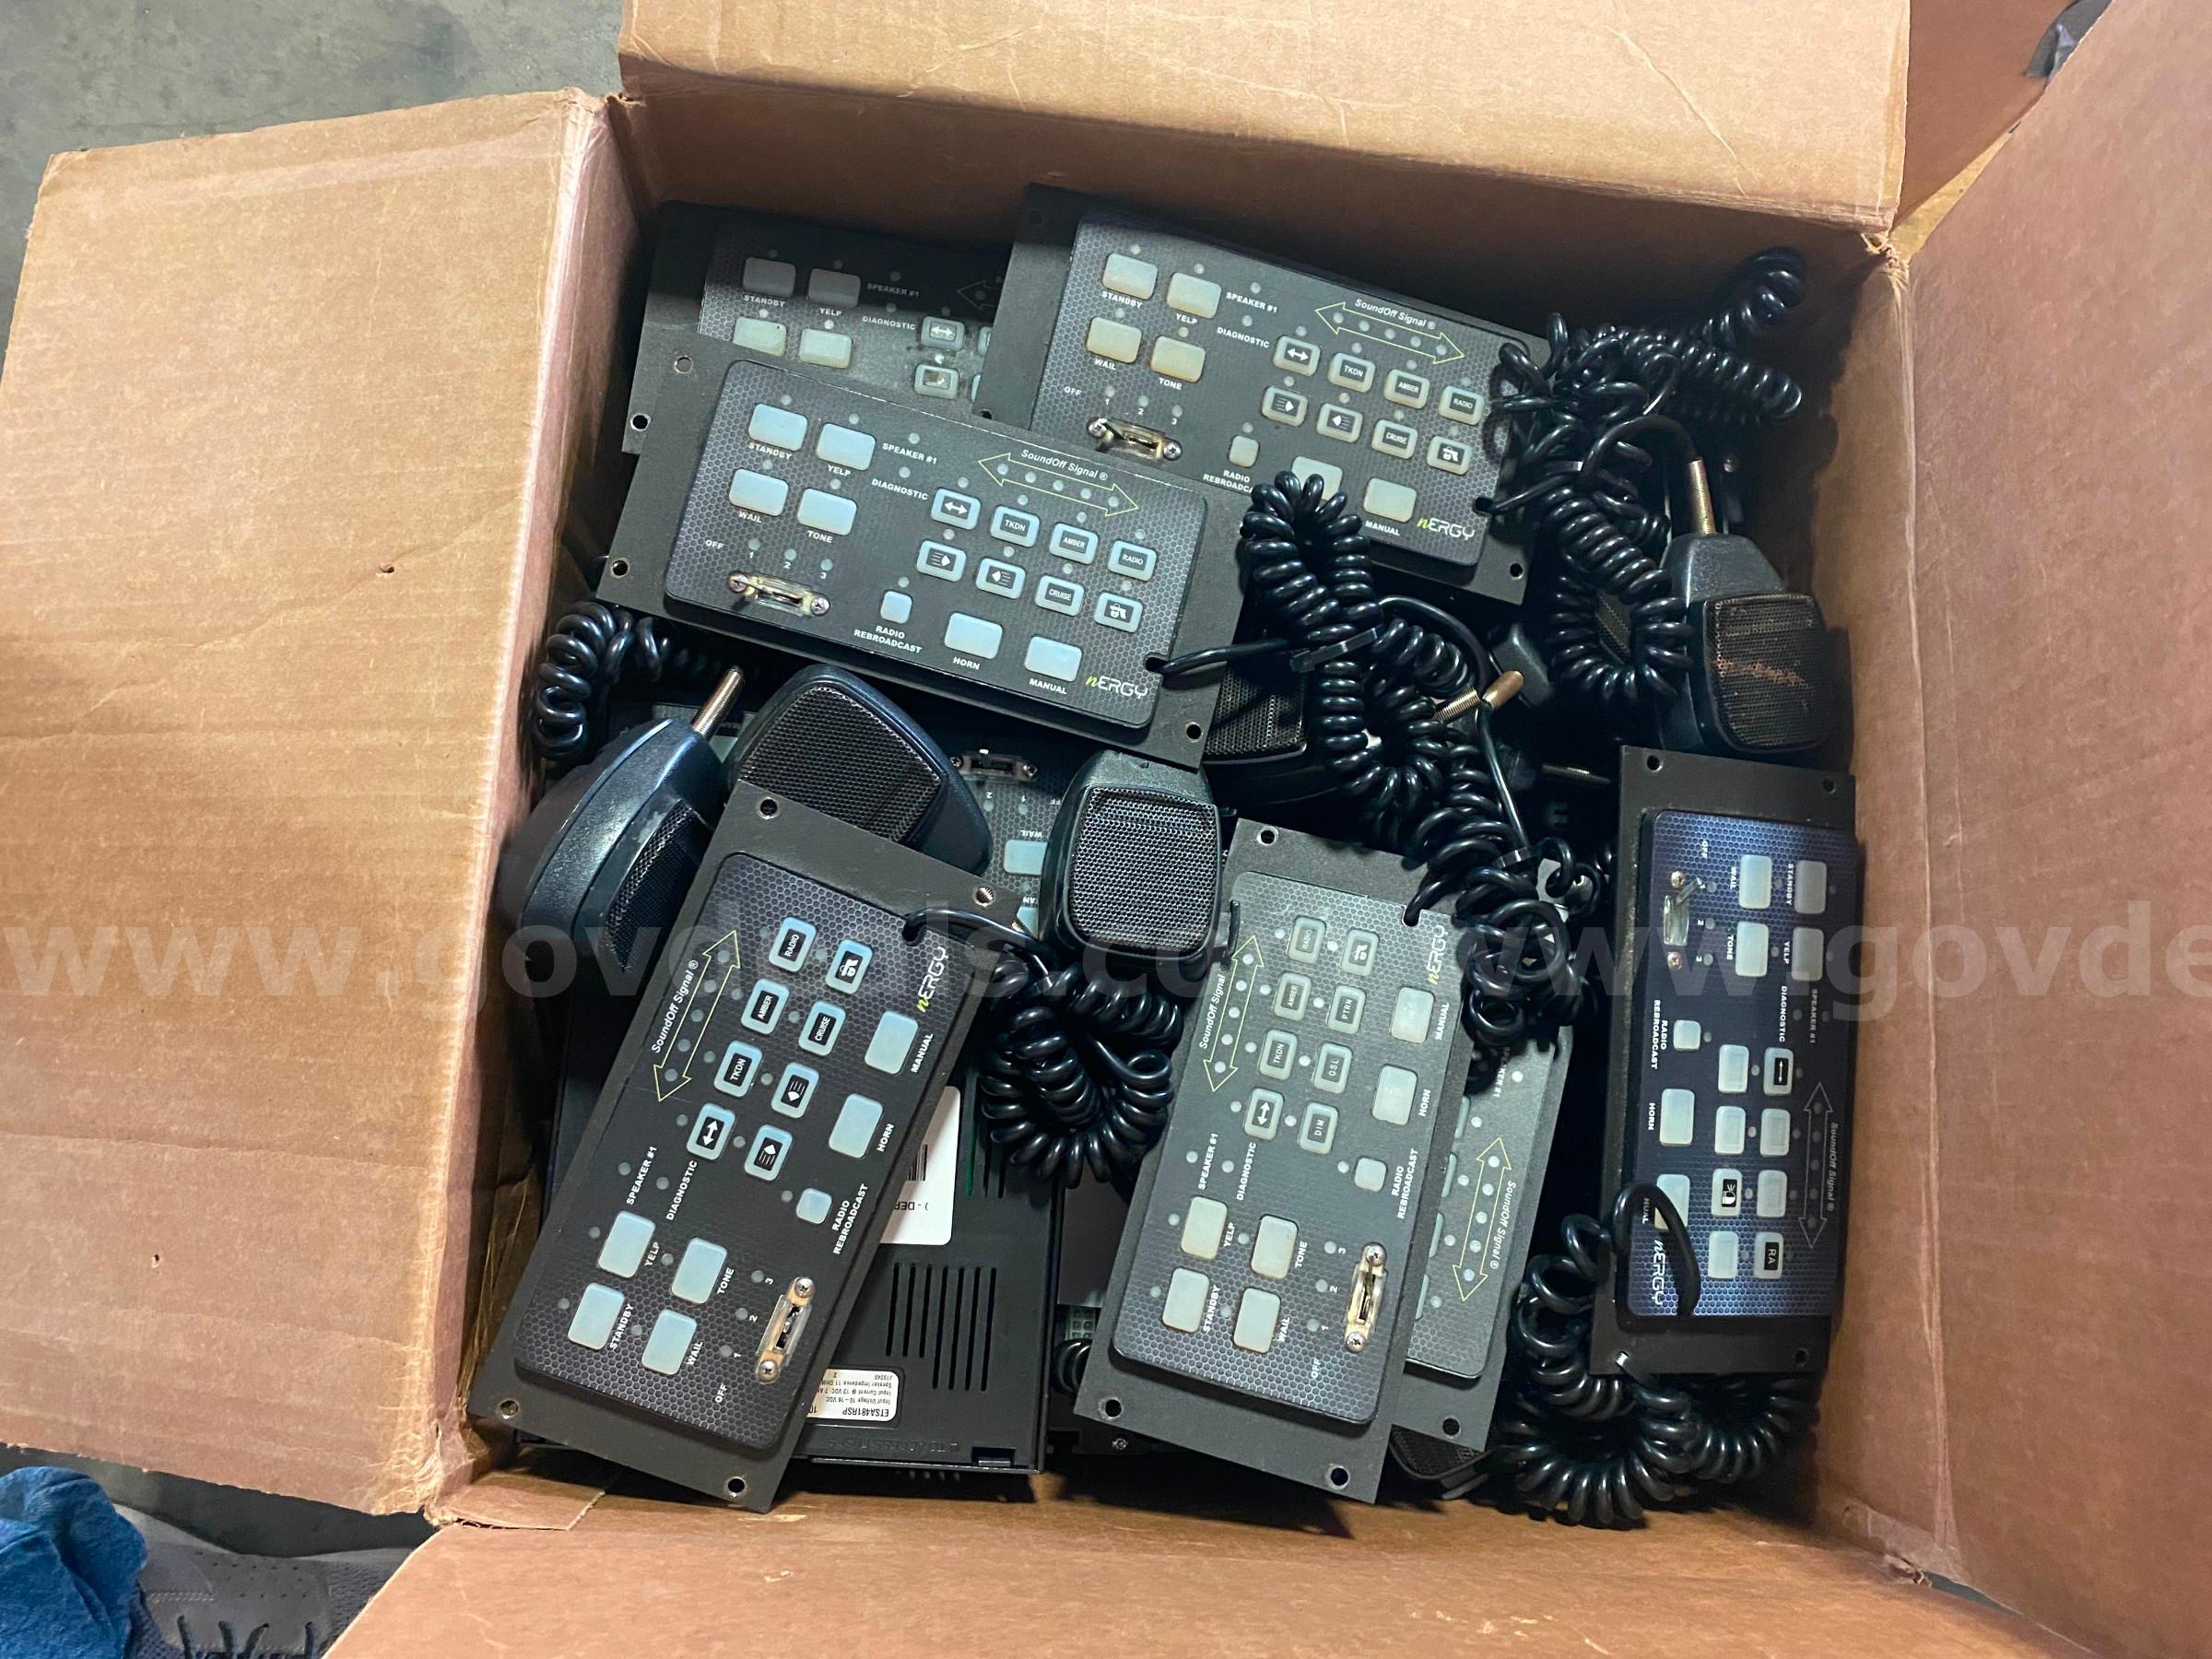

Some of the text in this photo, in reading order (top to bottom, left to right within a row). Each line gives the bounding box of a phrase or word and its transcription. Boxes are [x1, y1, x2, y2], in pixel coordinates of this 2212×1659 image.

[744, 294, 785, 308] STANDBY
[1101, 291, 1144, 309] STANDBY
[1226, 291, 1277, 313] SPEAKER #1
[819, 307, 842, 317] YELP
[863, 314, 916, 331] DIAGNOSTIC
[1175, 312, 1198, 324] YELP
[1355, 298, 1397, 318] SoundOff
[1398, 310, 1427, 328] Signal
[1217, 326, 1270, 348] DIAGNOSTIC
[1094, 358, 1117, 371] WAIL
[1344, 364, 1364, 378] TKDN
[1064, 385, 1082, 397] OFF
[1159, 377, 1182, 391] TONE
[1398, 382, 1419, 394] AMBER
[1453, 397, 1474, 409] RADIO
[1386, 431, 1408, 444] CRUISE
[748, 442, 793, 460] STANDBY
[882, 442, 937, 465] SPEAKER #1
[829, 465, 851, 477] YELP
[1021, 449, 1066, 471] SoundOff
[1067, 463, 1098, 480] Signal
[1223, 469, 1251, 483] RADIO
[872, 478, 929, 500] DIAGNOSTIC
[738, 511, 762, 524] WAIL
[1005, 519, 1026, 532] TKDN
[1366, 520, 1400, 536] MANUAL
[705, 539, 724, 550] OFF
[807, 530, 832, 543] TONE
[1063, 536, 1086, 549] AMBER
[749, 551, 754, 559] 1
[783, 561, 790, 570] 2
[1122, 553, 1144, 566] RADIO
[820, 571, 827, 580] 3
[1049, 588, 1072, 602] CRUISE
[853, 629, 922, 654] REBROADCAST
[876, 625, 905, 639] RADIO
[952, 656, 981, 670] HORN
[1030, 677, 1067, 695] MANUAL
[1021, 830, 1042, 839] WAIL
[784, 934, 800, 958] RADIO
[1301, 929, 1312, 950] RADIO
[759, 994, 772, 1018] AMBER
[1288, 985, 1298, 1007] AMBER
[652, 1003, 678, 1053] SoundOff
[673, 970, 694, 1004] Signal
[1199, 973, 1226, 1049] SoundOff Signal
[1342, 998, 1352, 1019] PTRN
[1779, 986, 1787, 1042] DIAGNOSTIC
[816, 1017, 830, 1041] CRUISE
[1435, 1003, 1450, 1041] MANUAL
[1650, 999, 1661, 1069] REBROADCAST
[911, 1032, 934, 1073] MANUAL
[1273, 1043, 1284, 1064] TKDN
[731, 1058, 746, 1080] TKDN
[1328, 1058, 1339, 1077] OSL
[1419, 1089, 1431, 1117] HORN
[877, 1123, 894, 1151] HORN
[1314, 1118, 1324, 1136] DIM
[1829, 1122, 1839, 1169] SoundOff
[1198, 1133, 1218, 1190] SPEAKER #1
[1237, 1142, 1256, 1200] DIAGNOSTIC
[627, 1146, 657, 1205] SPEAKER #1
[1392, 1165, 1404, 1197] RADIO
[1397, 1147, 1418, 1219] REBROADCAST
[1827, 1170, 1836, 1201] Signal
[666, 1160, 698, 1221] DIAGNOSTIC
[832, 1200, 850, 1231] RADIO
[1500, 1181, 1516, 1228] SoundOff
[833, 1183, 869, 1254] REBROADCAST
[1224, 1222, 1235, 1248] YELP
[1492, 1228, 1506, 1260] Signal
[645, 1241, 660, 1267] YELP
[1295, 1241, 1307, 1268] TONE
[717, 1267, 734, 1294] TONE
[1203, 1286, 1220, 1333] STANDBY
[610, 1303, 634, 1350] STANDBY
[1277, 1317, 1290, 1343] WAIL
[687, 1340, 703, 1366] WAIL
[1311, 1359, 1322, 1380] OFF
[715, 1383, 727, 1404] OFF
[842, 1407, 889, 1417] ETSA481RSP
